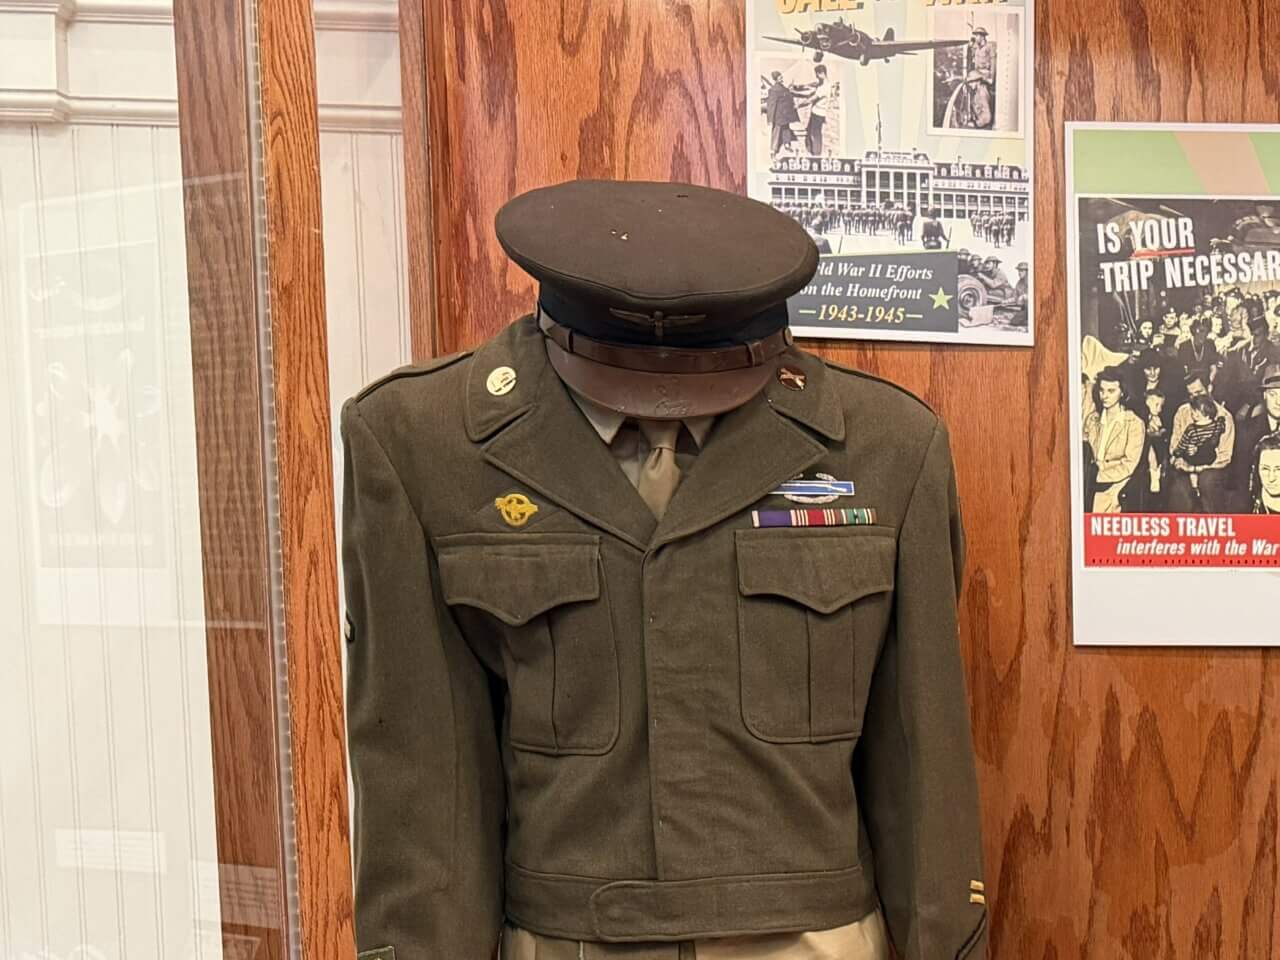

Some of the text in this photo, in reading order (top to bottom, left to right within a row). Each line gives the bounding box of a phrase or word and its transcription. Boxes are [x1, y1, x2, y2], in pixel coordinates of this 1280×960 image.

[1097, 217, 1195, 255] IS YOUR
[817, 262, 933, 283] rld War II Efforts
[1100, 260, 1154, 293] TRIP
[821, 283, 841, 296] the
[846, 284, 922, 302] Homefront
[1091, 517, 1235, 536] NEEDLESS TRAVEL
[1117, 539, 1185, 555] interferes
[1191, 540, 1220, 555] with
[1225, 540, 1246, 555] the
[1253, 540, 1279, 555] War
